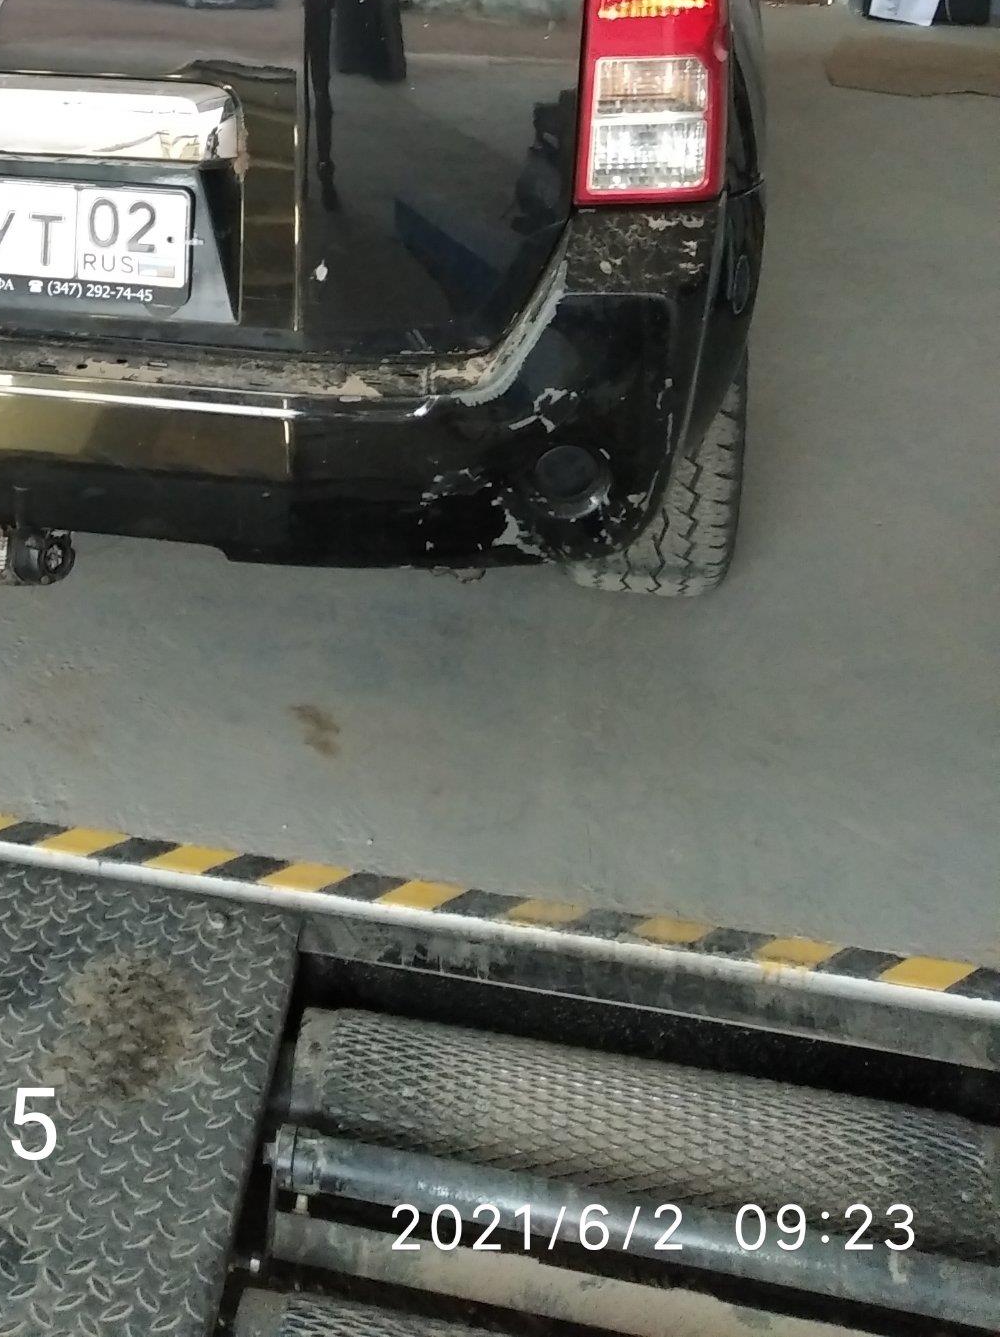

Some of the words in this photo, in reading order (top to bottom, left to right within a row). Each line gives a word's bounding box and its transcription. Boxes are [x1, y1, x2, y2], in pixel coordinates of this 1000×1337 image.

[87, 196, 158, 254] 02
[83, 253, 135, 275] RUS
[46, 280, 84, 300] (347)
[85, 282, 154, 302] 292-74-45
